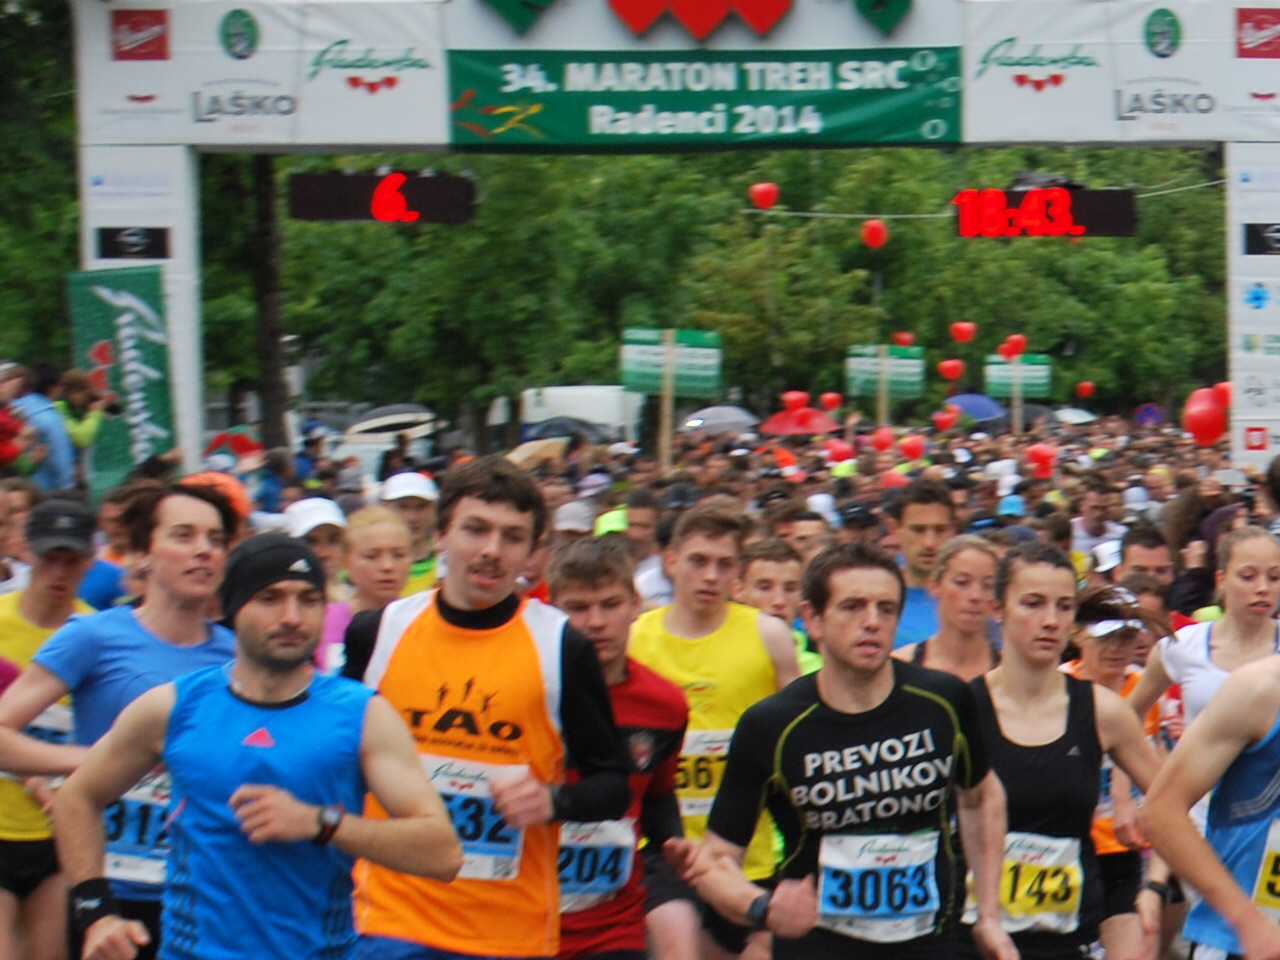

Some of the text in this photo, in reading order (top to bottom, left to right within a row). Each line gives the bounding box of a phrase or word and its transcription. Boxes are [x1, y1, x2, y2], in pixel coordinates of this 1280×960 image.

[500, 60, 909, 93] 34. MARATON TREH SRC
[191, 90, 297, 123] LAŠKO
[589, 103, 824, 134] Radenci 2014
[1114, 88, 1217, 121] LAŠKO
[803, 728, 936, 778] PREVOZI
[789, 755, 954, 806] BOLNIKOV
[441, 792, 512, 843] 32
[829, 864, 931, 911] 3063
[1008, 863, 1072, 906] 143
